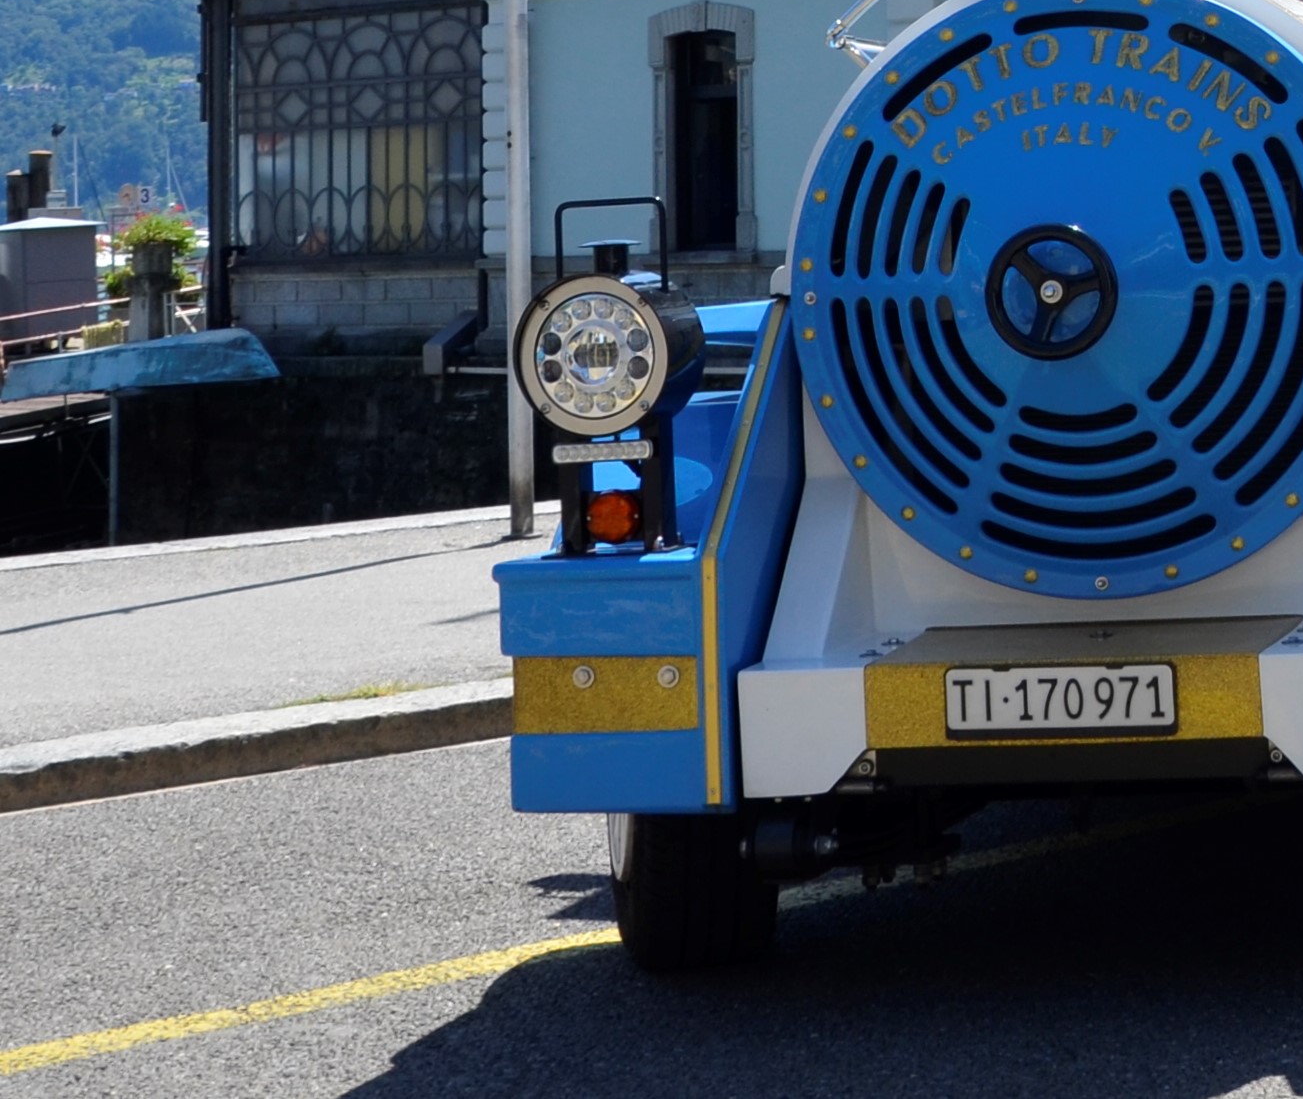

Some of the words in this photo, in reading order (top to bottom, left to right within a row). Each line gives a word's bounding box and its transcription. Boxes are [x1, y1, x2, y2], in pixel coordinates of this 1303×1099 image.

[892, 32, 1061, 148] DOTTO
[1088, 29, 1273, 131] TRAINS
[932, 81, 1193, 165] CASTELFRANCO
[1021, 121, 1119, 151] ITALY
[140, 188, 150, 203] 3
